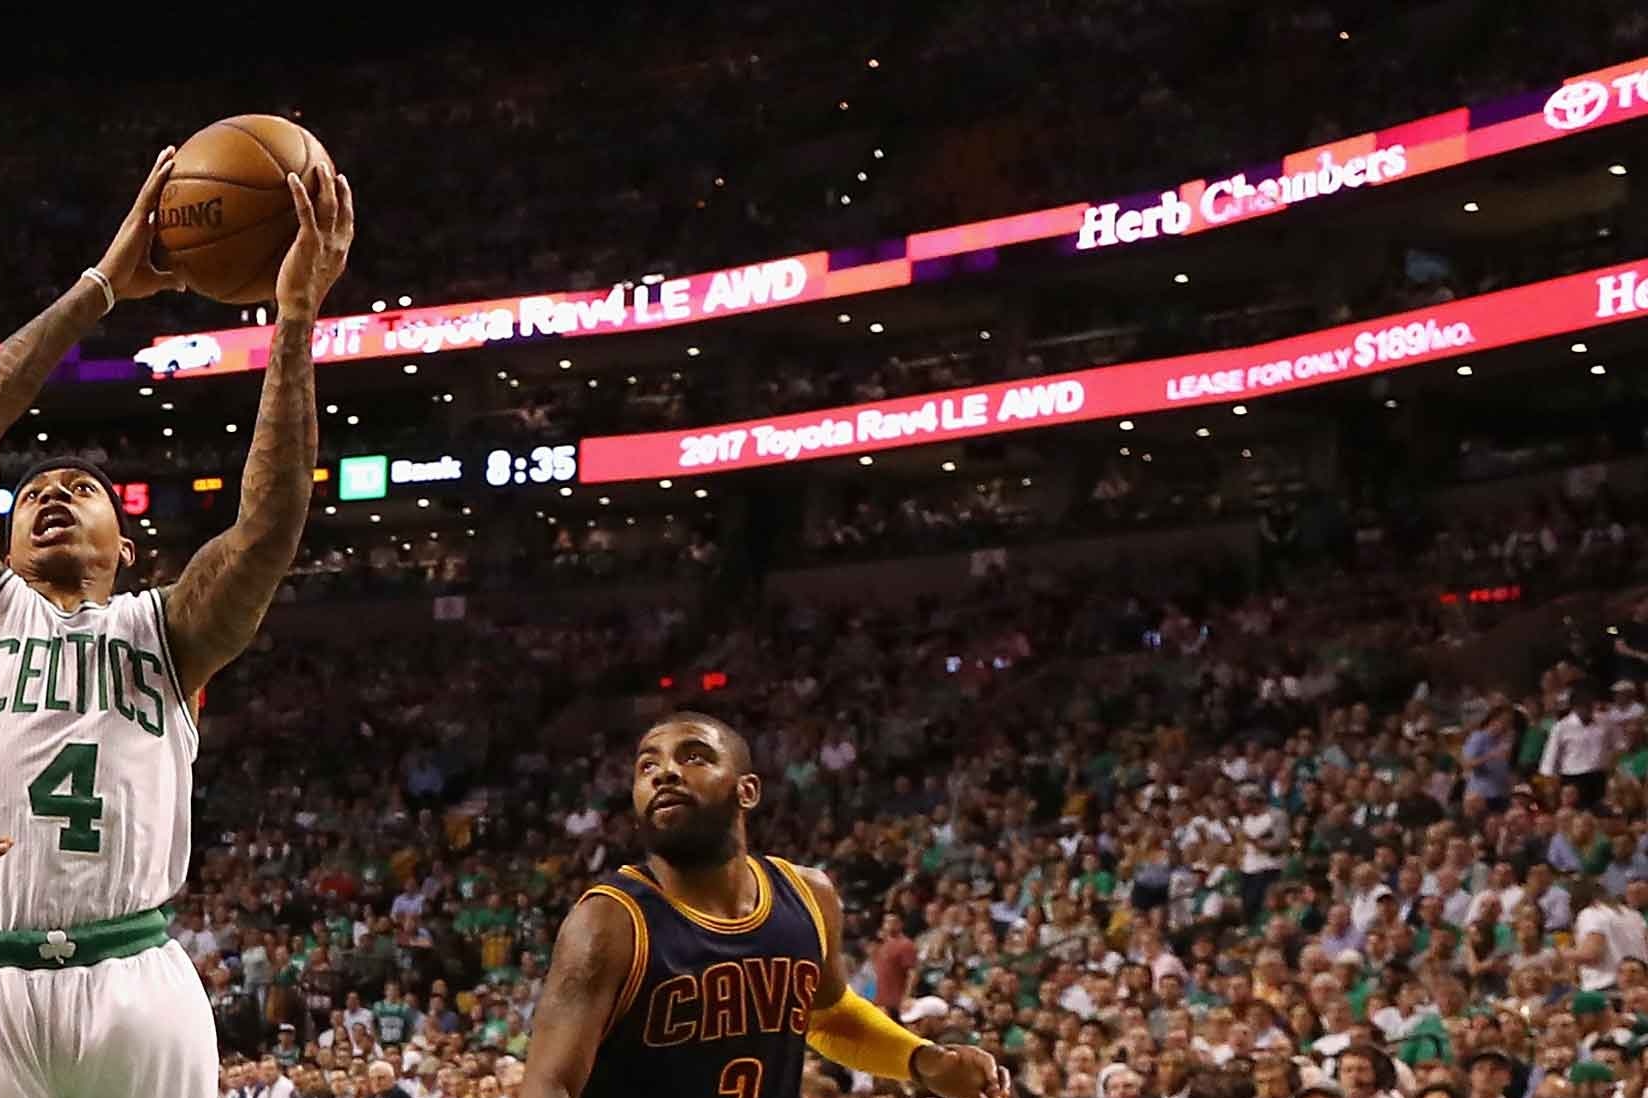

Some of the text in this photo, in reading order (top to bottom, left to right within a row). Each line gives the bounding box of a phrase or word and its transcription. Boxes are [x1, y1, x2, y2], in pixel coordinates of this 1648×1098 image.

[1076, 144, 1407, 250] Herb Chambers
[379, 308, 514, 353] Toyota
[519, 282, 628, 337] Rav4
[634, 278, 691, 324] LE
[704, 257, 807, 313] AWD
[1166, 368, 1244, 400] LEASE
[1248, 360, 1294, 389] FOR
[1294, 346, 1352, 380] ONLY
[486, 445, 577, 486] 8:35
[679, 380, 1084, 468] 2017 Toyota Rav4 LE AWD
[28, 742, 103, 853] 4
[643, 957, 820, 1047] CAVS
